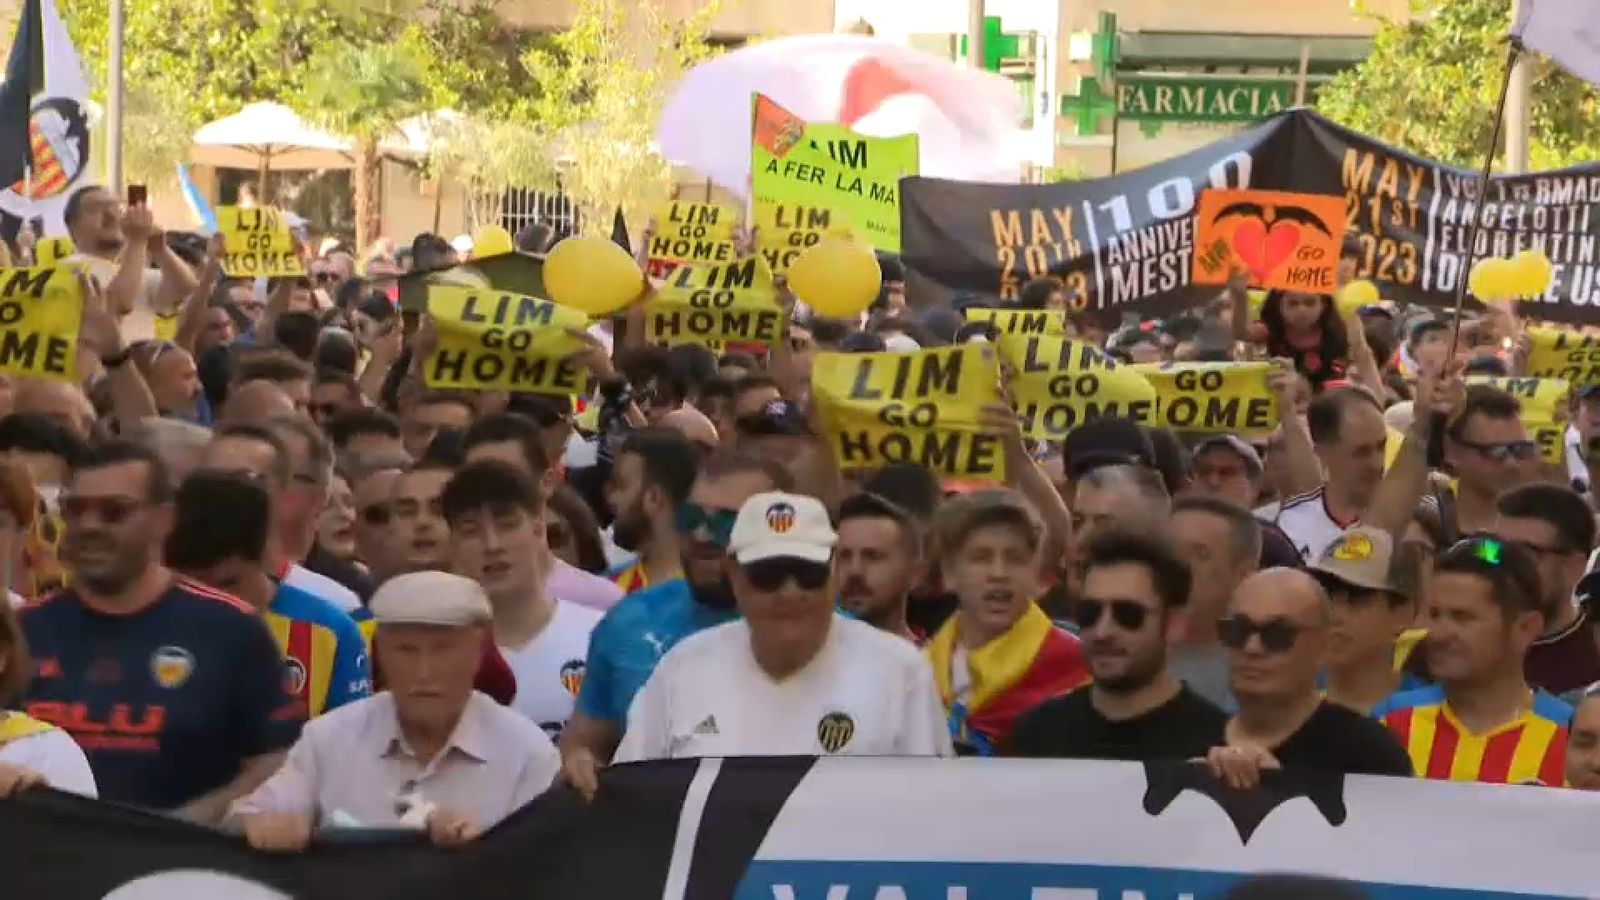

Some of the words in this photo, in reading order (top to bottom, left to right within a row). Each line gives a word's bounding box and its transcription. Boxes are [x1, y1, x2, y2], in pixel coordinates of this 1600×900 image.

[1117, 85, 1282, 116] FARMACIA
[809, 139, 868, 170] IM
[765, 159, 779, 176] A
[784, 161, 826, 184] FER
[835, 173, 863, 197] LA
[1099, 149, 1253, 233] 100
[1341, 148, 1425, 205] MAY
[669, 203, 719, 226] LIM
[774, 205, 831, 230] LIM
[990, 206, 1074, 247] MAY
[246, 234, 271, 250] GO
[679, 225, 706, 239] GO
[787, 232, 820, 247] GO
[1107, 215, 1194, 266] ANNIVE
[224, 252, 298, 272] HOME
[652, 237, 731, 261] HOME
[762, 247, 801, 270] HO
[1296, 246, 1326, 260] GO
[1356, 233, 1418, 286] 023
[674, 258, 756, 290] LIM
[1111, 246, 1195, 305] MEST
[1286, 266, 1334, 287] HOME
[460, 295, 556, 326] LIM
[690, 290, 735, 309] GO
[481, 328, 533, 353] GO
[654, 311, 778, 341] HOME
[0, 330, 69, 373] ME
[433, 350, 578, 388] HOME
[849, 349, 964, 400] LIM
[1174, 369, 1224, 392] GO
[1048, 373, 1100, 399] GO
[878, 403, 939, 429] GO
[1154, 395, 1272, 428] OME
[839, 430, 998, 474] HOME
